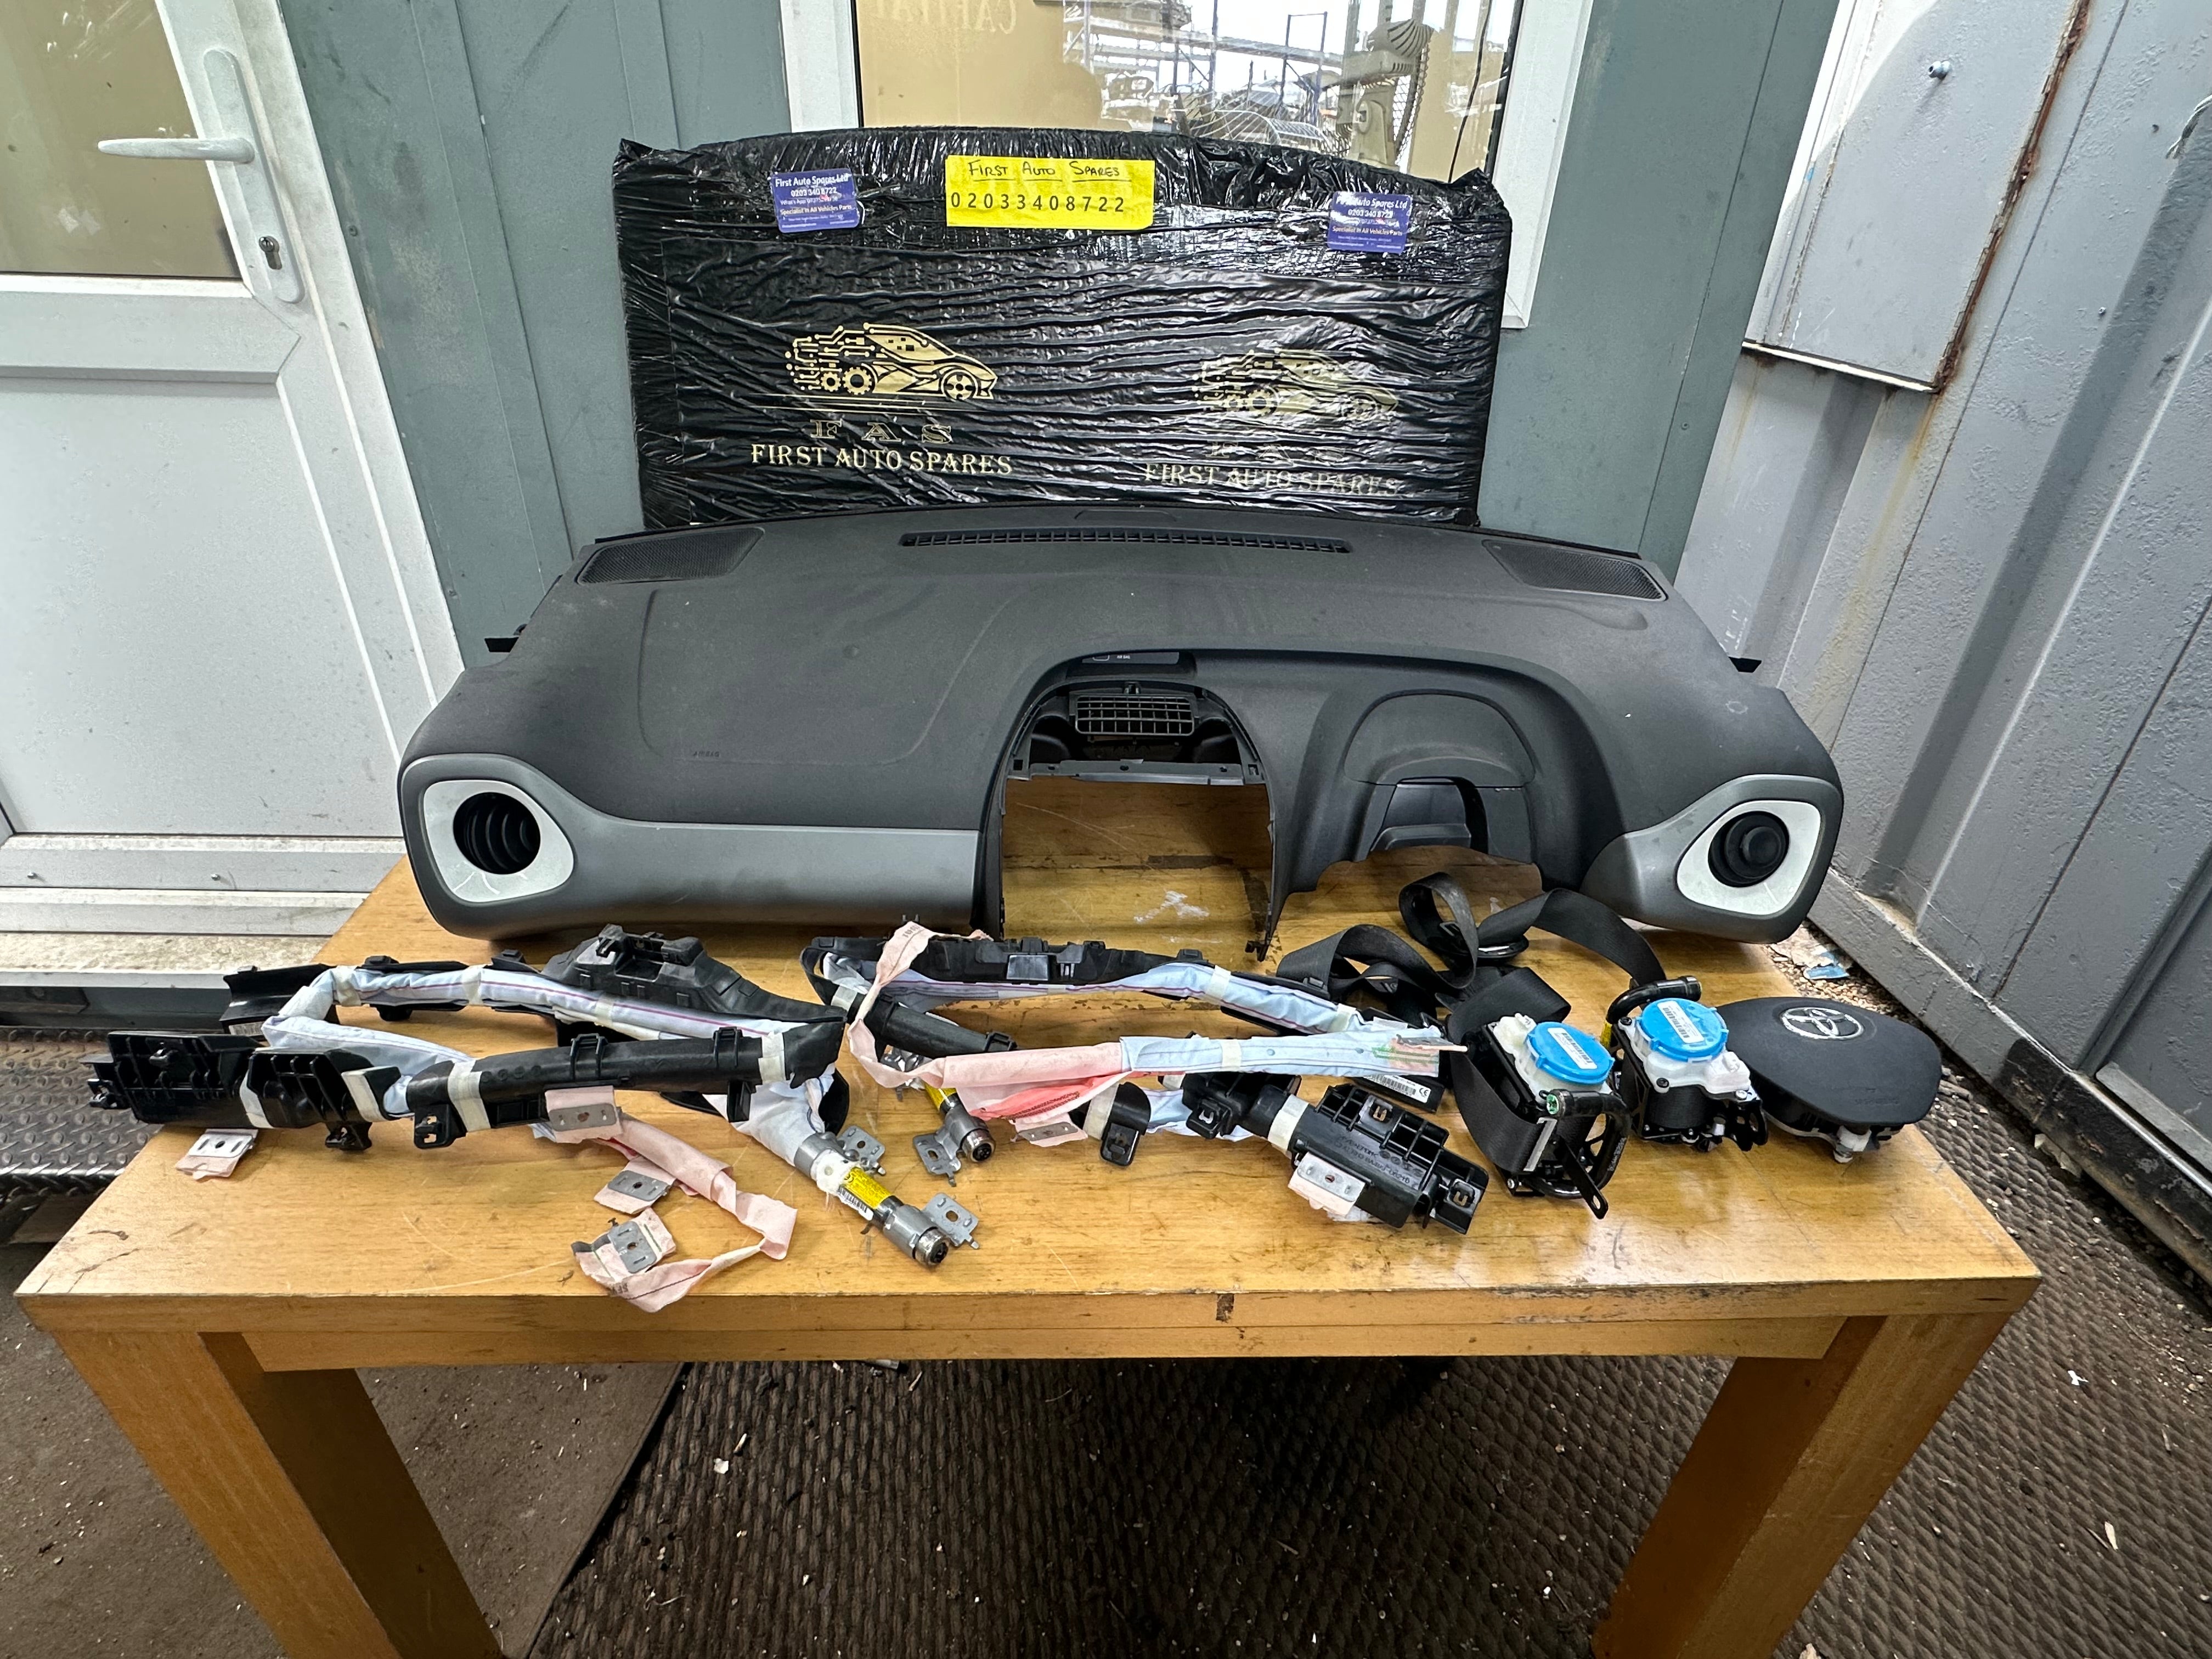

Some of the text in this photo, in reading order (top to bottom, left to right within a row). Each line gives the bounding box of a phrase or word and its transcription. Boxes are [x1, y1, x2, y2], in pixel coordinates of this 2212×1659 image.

[968, 159, 1120, 177] FIRST AUTO SPARES
[775, 178, 792, 188] First
[793, 177, 811, 186] Auto
[811, 174, 836, 185] Spares
[790, 187, 837, 198] 0203 340 8722
[1371, 198, 1395, 210] Spares
[1395, 200, 1408, 209] Ltd
[751, 444, 1013, 475] FIRST AUTO SPARES
[1144, 463, 1408, 496] FIRST AUTO SPARES
